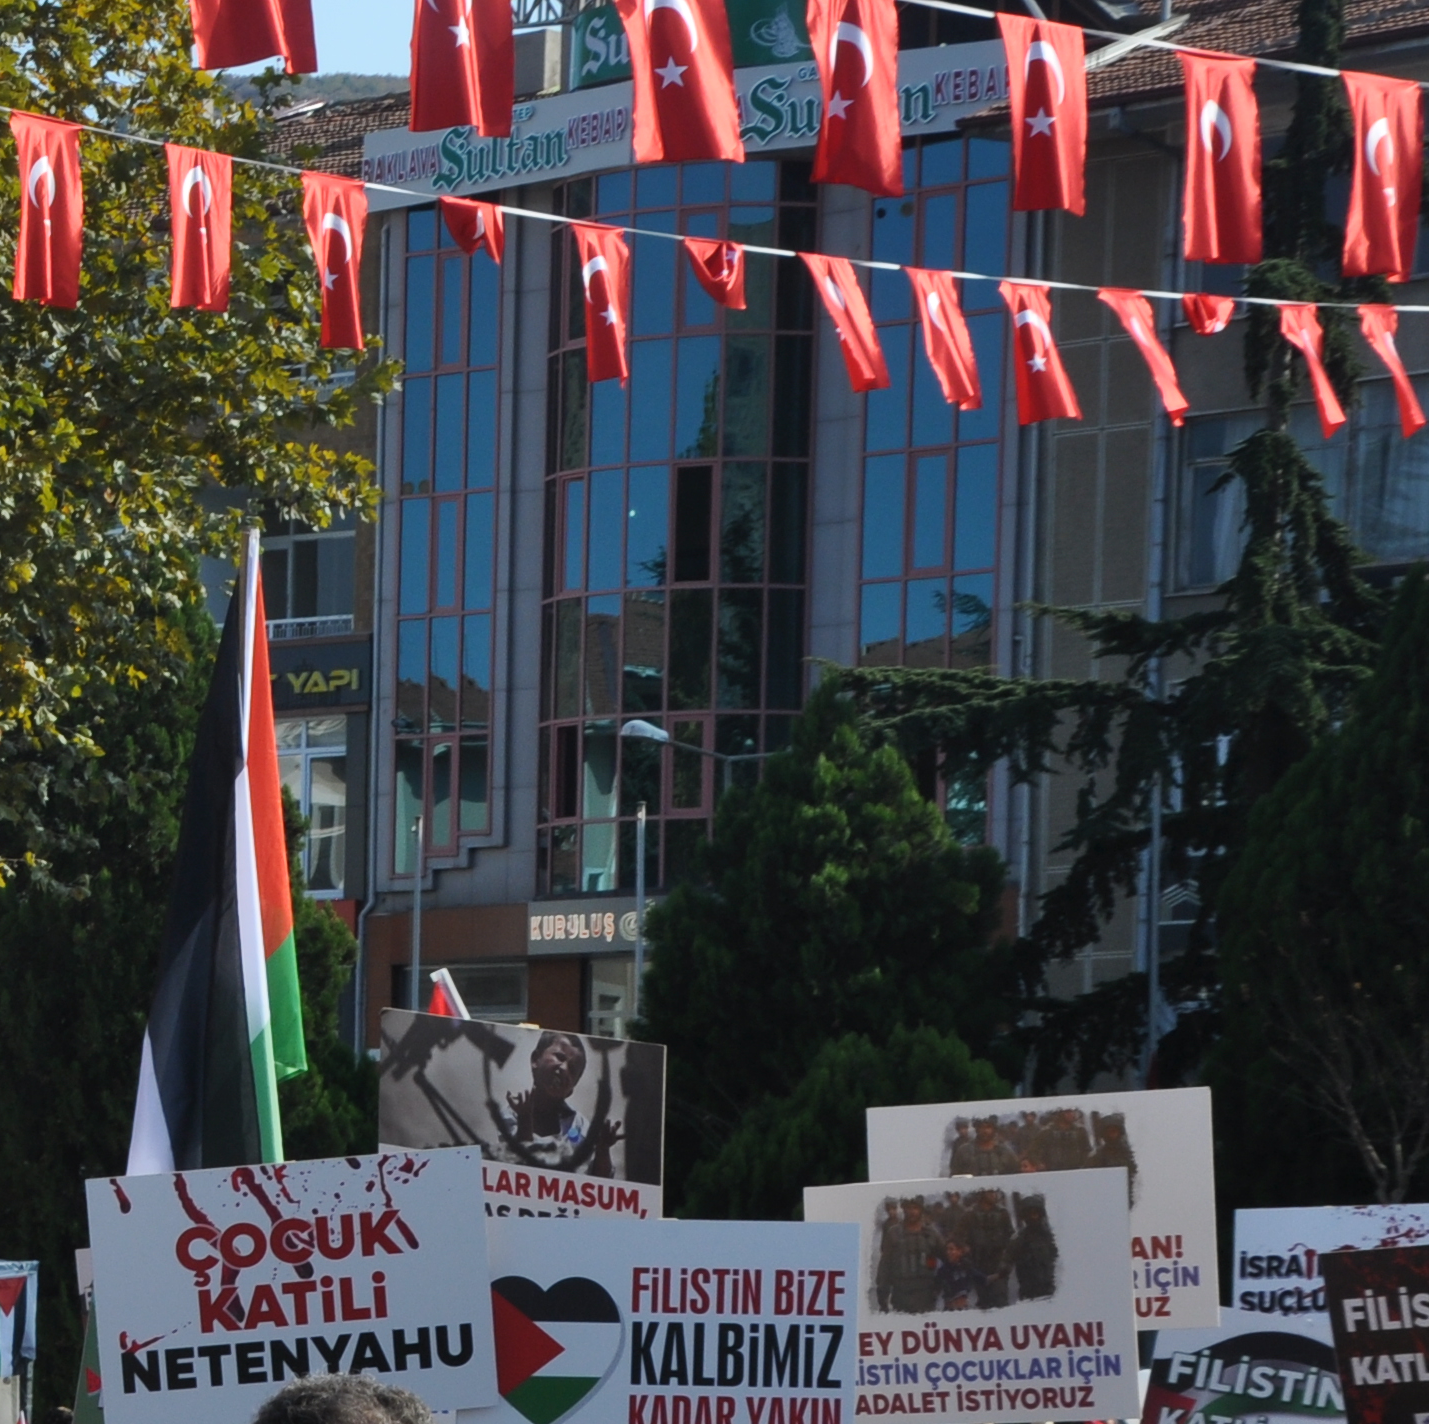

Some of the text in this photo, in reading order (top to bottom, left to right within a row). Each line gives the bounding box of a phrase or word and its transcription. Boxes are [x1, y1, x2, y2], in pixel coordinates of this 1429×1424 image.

[362, 106, 627, 191] BAKLAVA Sultan KEBAP
[286, 668, 359, 694] YAPI
[537, 1175, 648, 1219] MASUM,
[175, 1208, 404, 1288] ÇOCUK
[1144, 1260, 1200, 1295] İÇİN
[120, 1322, 474, 1394] NETENYAHU
[901, 1321, 1004, 1355] DÜNYA
[1010, 1321, 1105, 1350] UYAN!
[854, 1349, 1121, 1390] İSTİN ÇOCUKLAR İÇİN
[854, 1383, 1095, 1415] ADALET İSTİYORUZ
